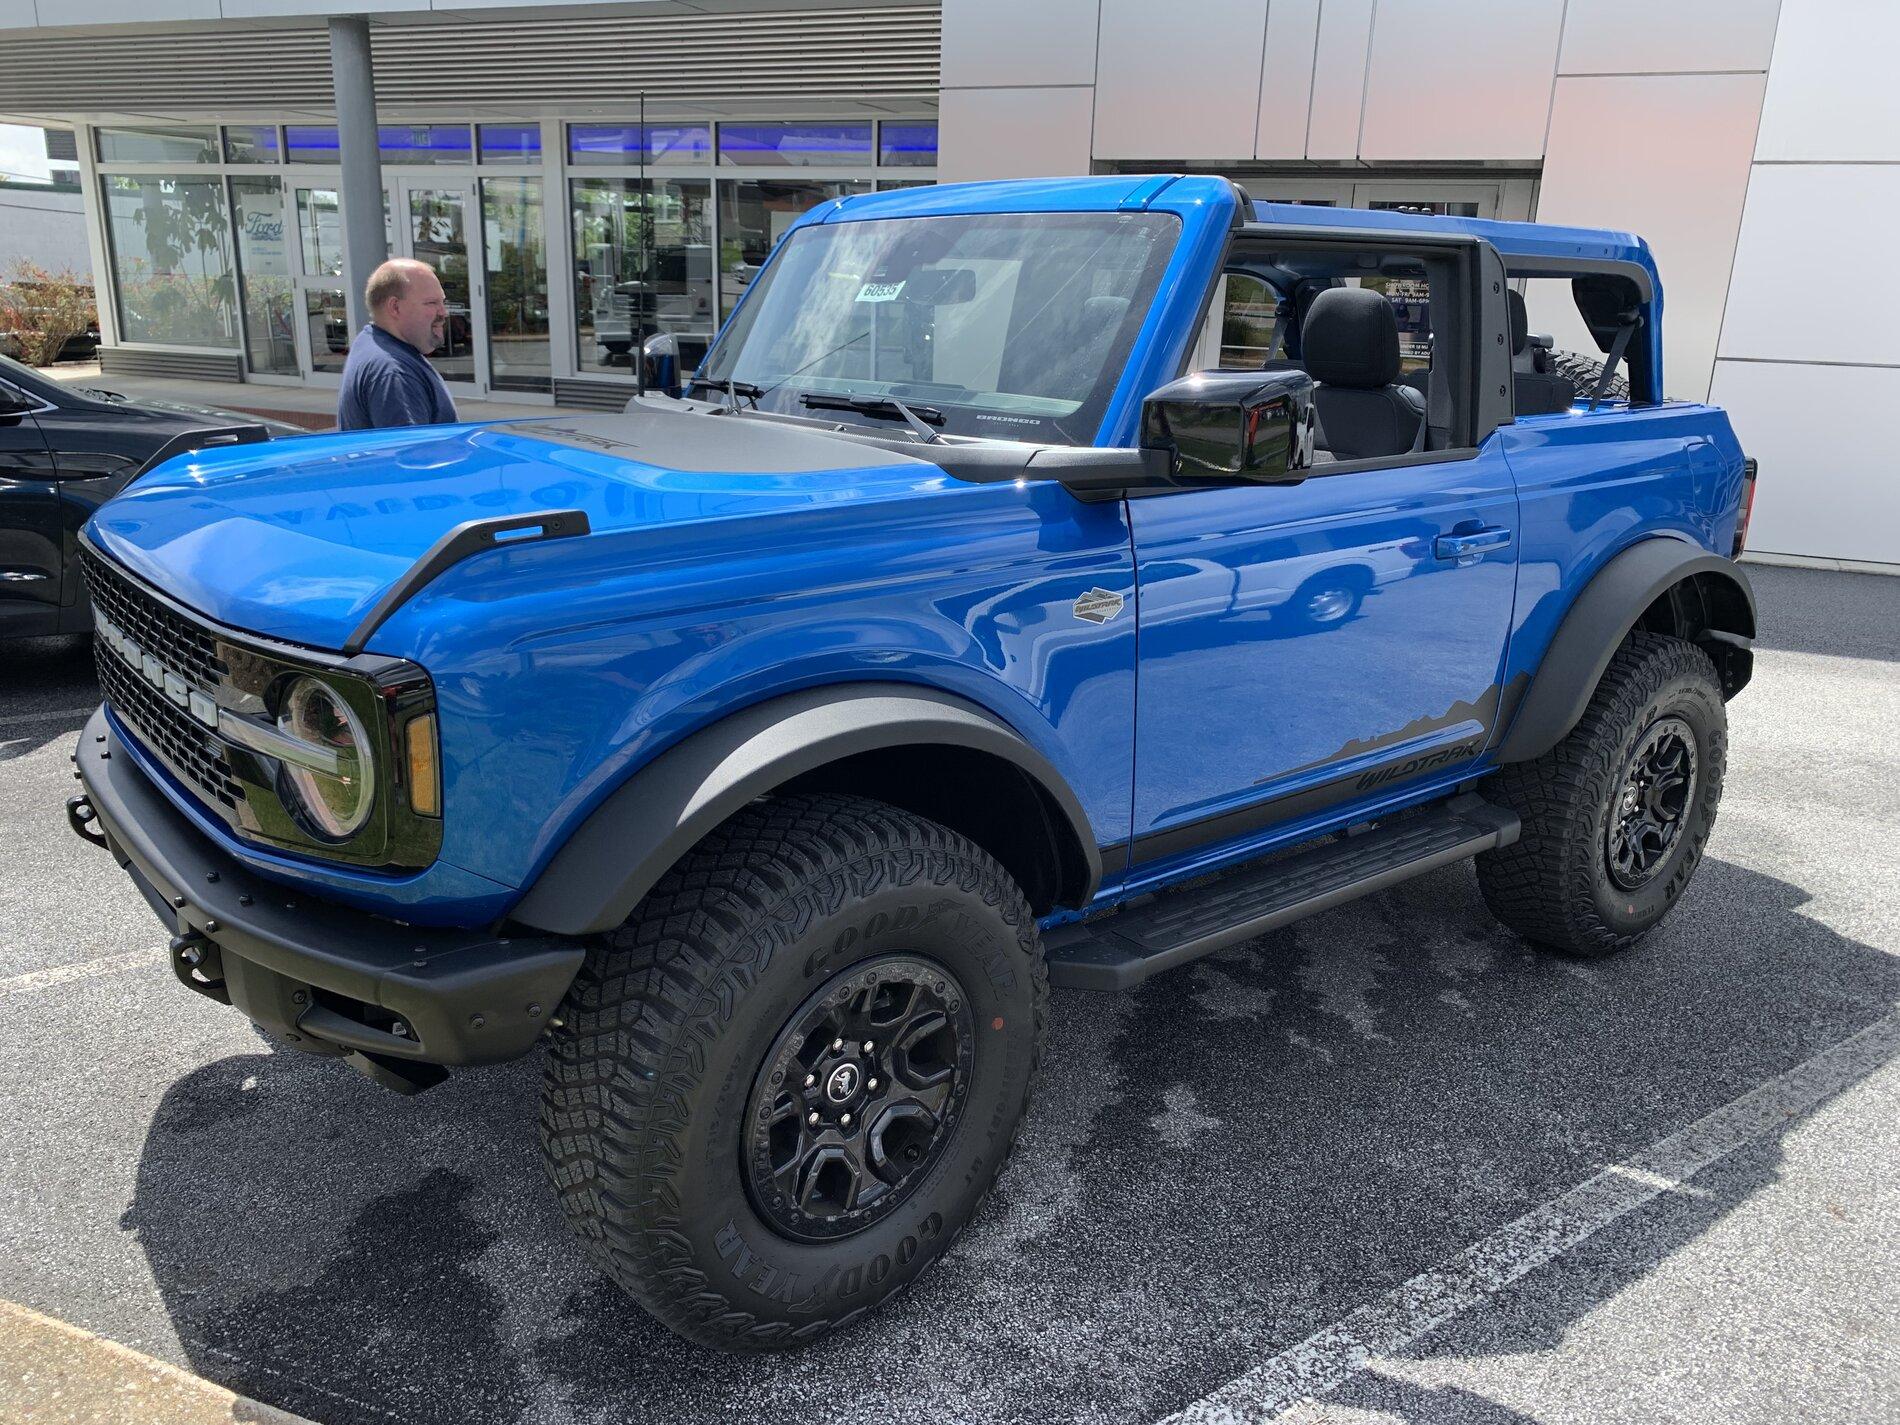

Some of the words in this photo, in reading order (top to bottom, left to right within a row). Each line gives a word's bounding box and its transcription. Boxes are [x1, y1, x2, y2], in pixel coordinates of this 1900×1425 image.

[245, 211, 283, 234] Ford
[976, 414, 1041, 425] BRONCO
[1355, 739, 1482, 790] WILDTRAK
